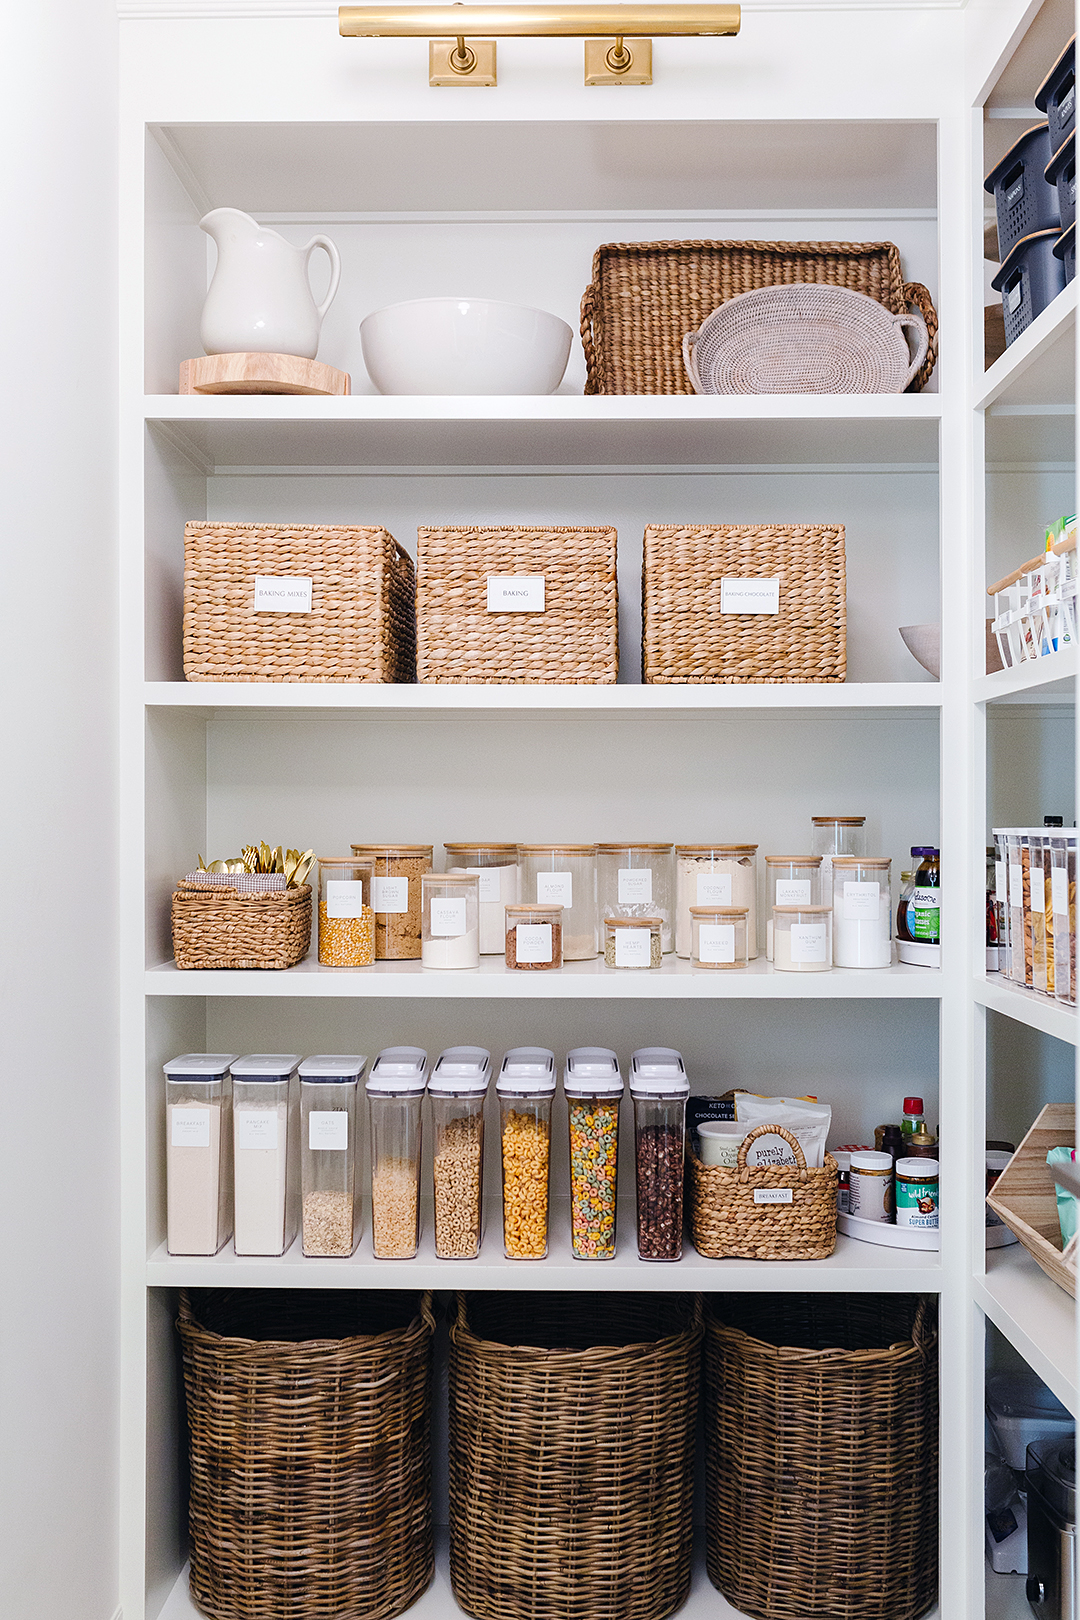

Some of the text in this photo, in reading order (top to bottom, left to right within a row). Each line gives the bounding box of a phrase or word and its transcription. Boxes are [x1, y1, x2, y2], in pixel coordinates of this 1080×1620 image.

[258, 589, 308, 598] BAKING MIXES
[502, 589, 529, 597] BAKING
[755, 1146, 784, 1160] purely
[908, 1218, 926, 1226] SUPER
